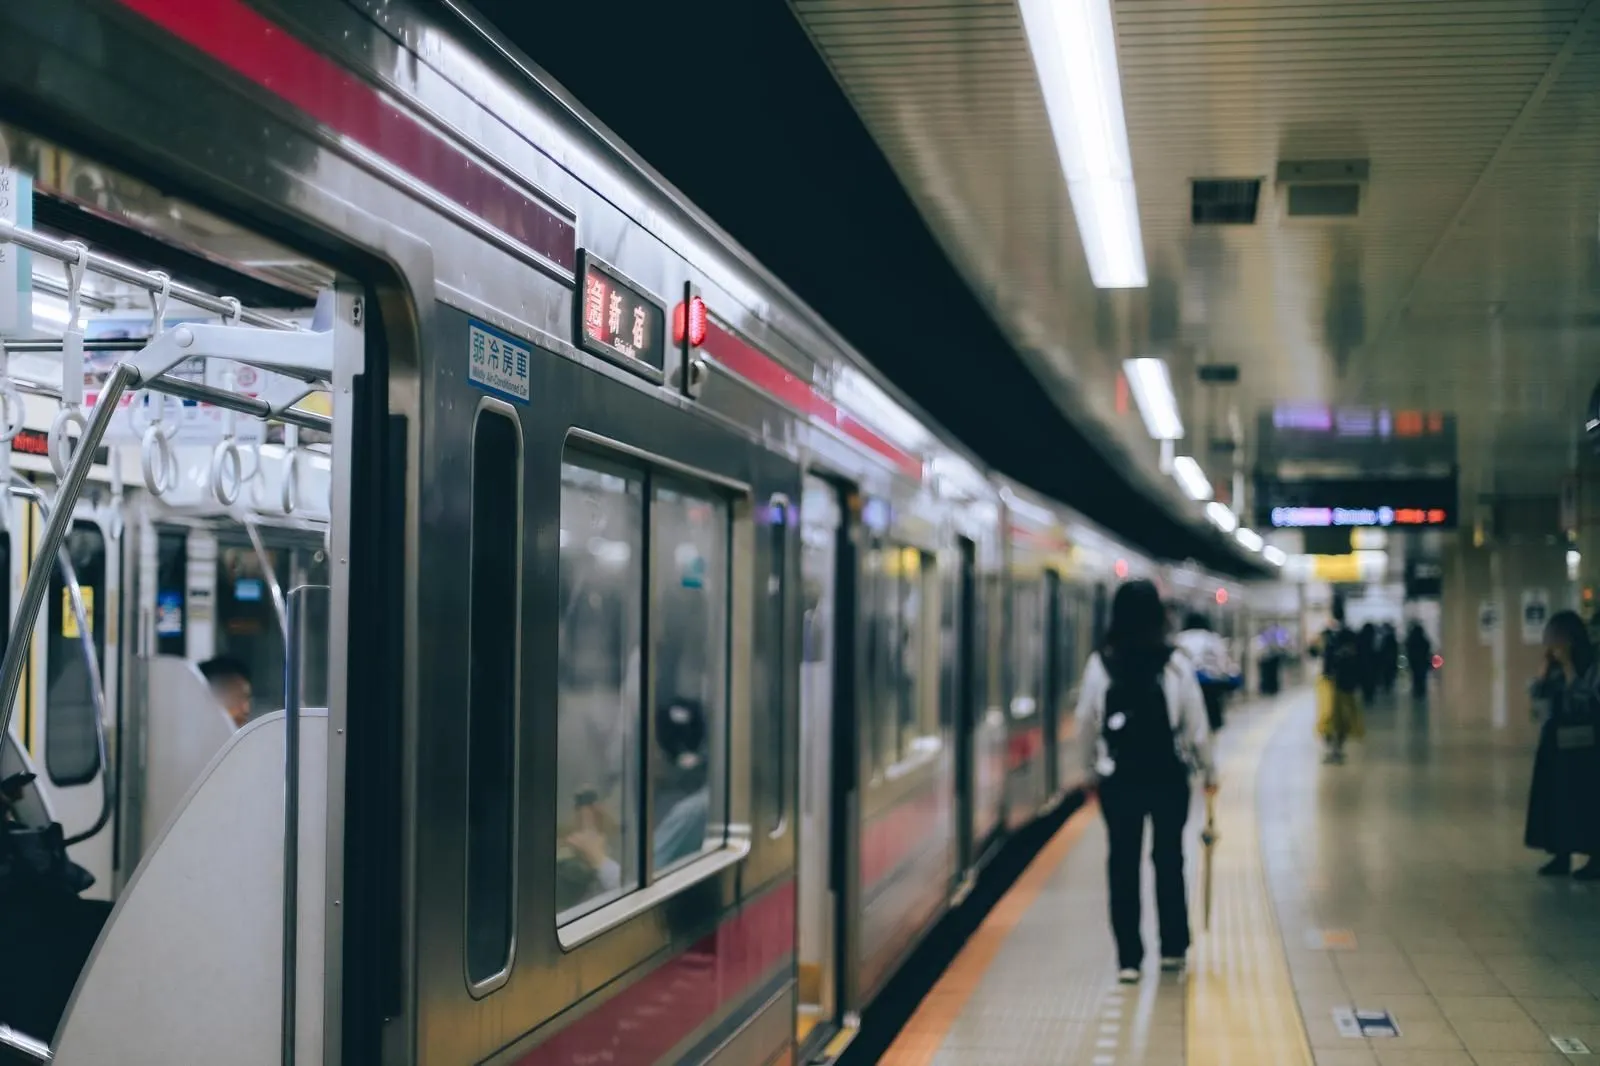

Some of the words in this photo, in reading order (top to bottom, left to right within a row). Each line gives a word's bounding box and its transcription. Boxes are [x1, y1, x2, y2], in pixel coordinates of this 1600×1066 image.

[608, 290, 646, 349] 新宿
[472, 331, 528, 381] 弱冷房車
